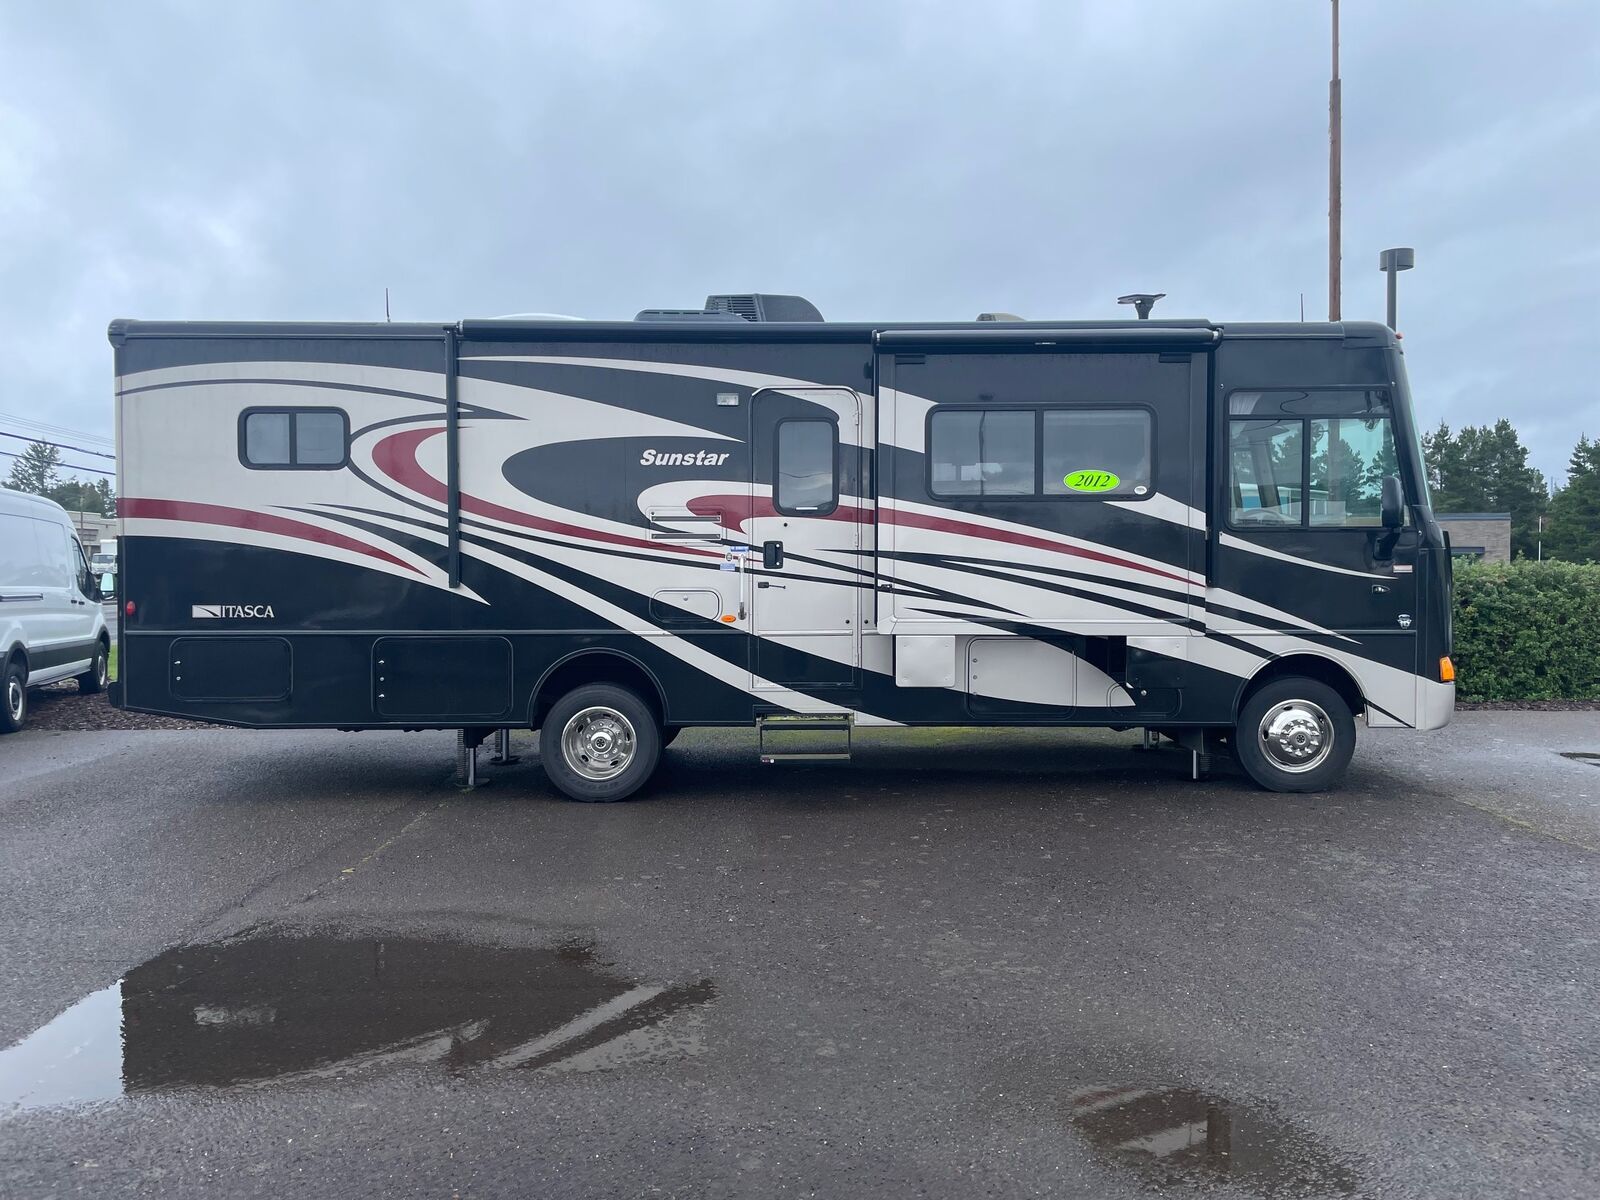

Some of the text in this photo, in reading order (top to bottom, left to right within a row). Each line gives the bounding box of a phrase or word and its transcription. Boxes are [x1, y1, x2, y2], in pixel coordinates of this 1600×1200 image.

[640, 449, 729, 466] Sunstar
[1074, 474, 1111, 487] 2012
[222, 605, 275, 618] ITASCA
